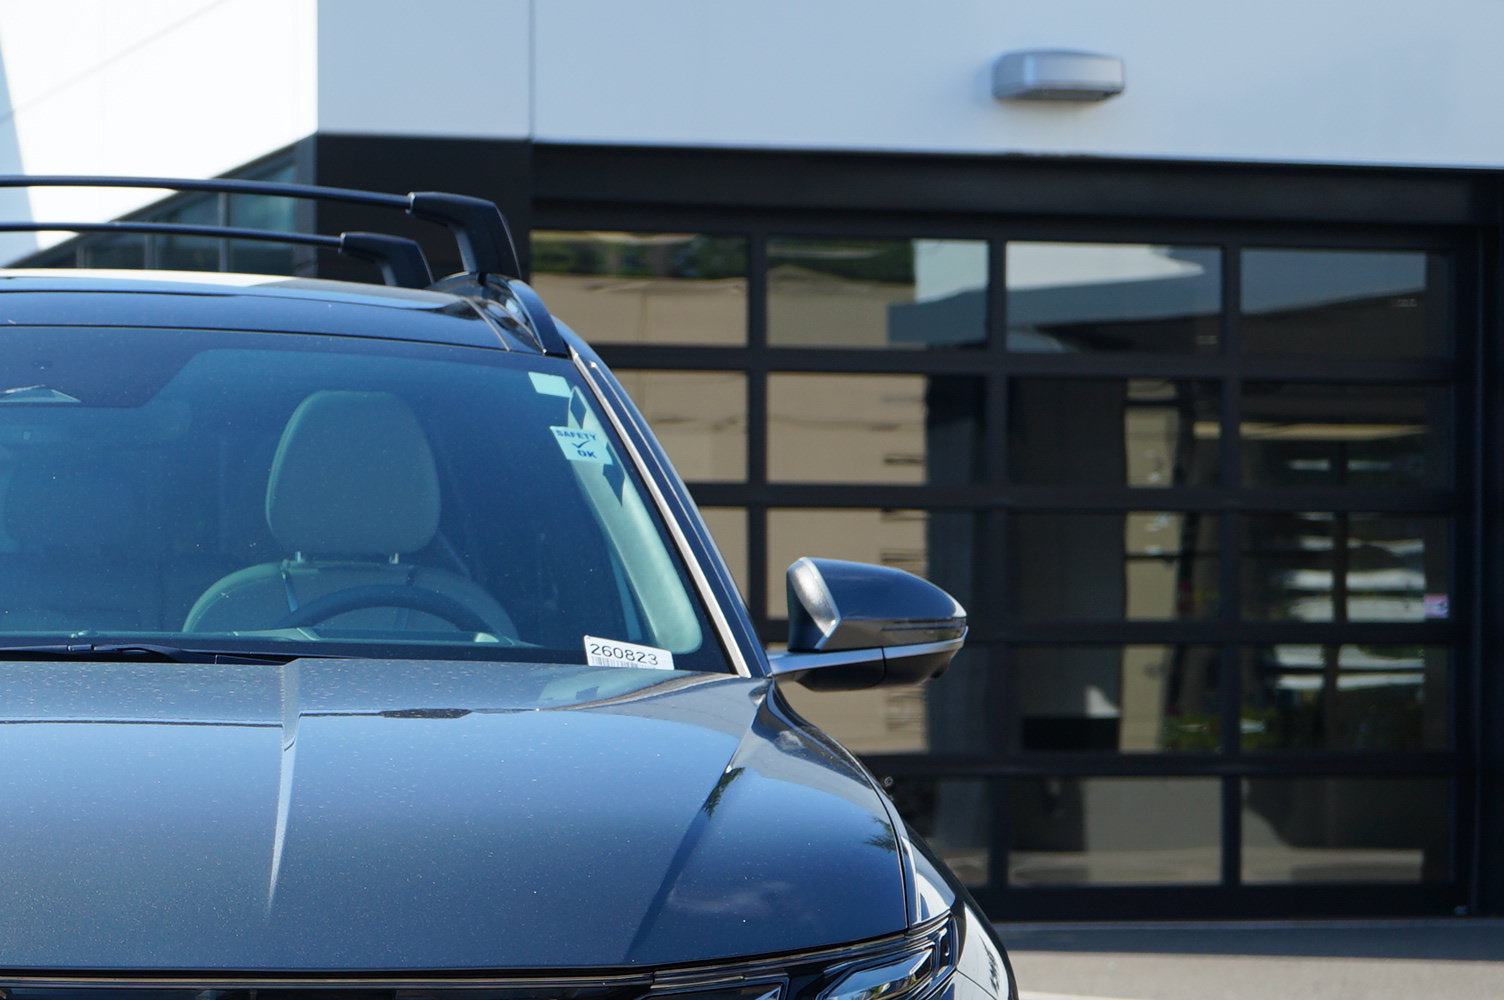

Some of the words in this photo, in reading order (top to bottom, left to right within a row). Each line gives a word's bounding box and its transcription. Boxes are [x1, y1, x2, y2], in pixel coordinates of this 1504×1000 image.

[556, 430, 596, 440] SAFETY
[577, 450, 597, 458] OK
[590, 643, 658, 665] 260823
